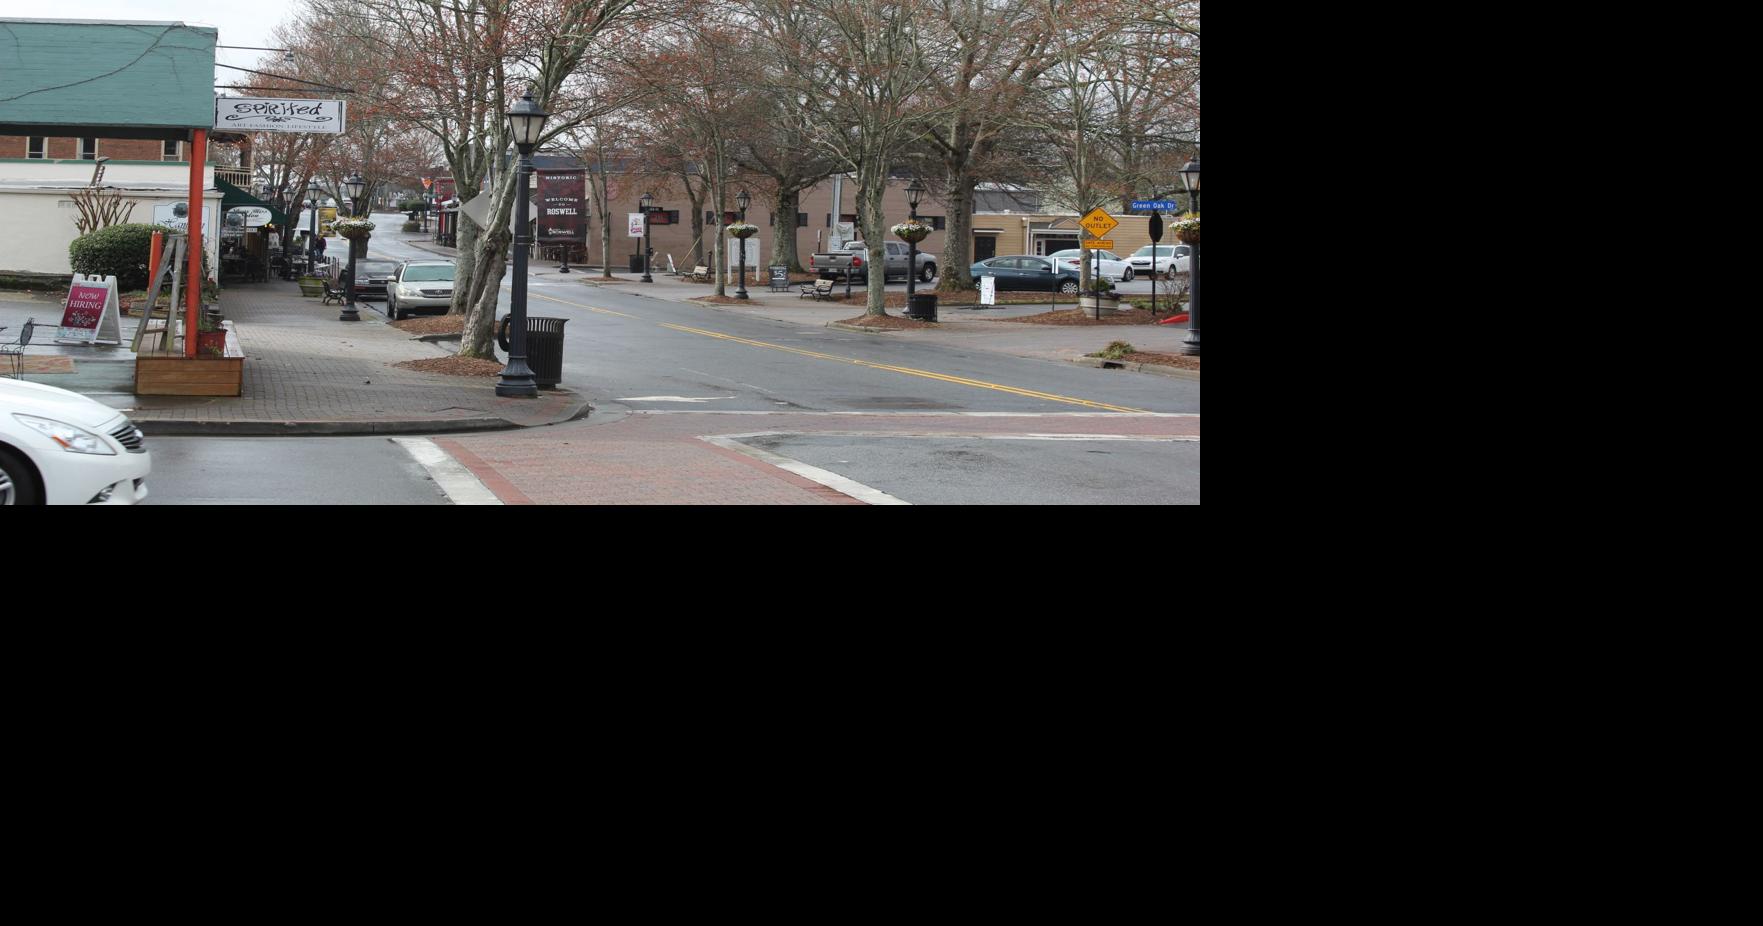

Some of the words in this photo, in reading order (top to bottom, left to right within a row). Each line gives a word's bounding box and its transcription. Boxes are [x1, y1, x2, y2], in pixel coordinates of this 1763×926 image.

[546, 208, 578, 216] ROSWELL
[78, 291, 100, 300] NOW
[69, 300, 102, 310] HIRING
